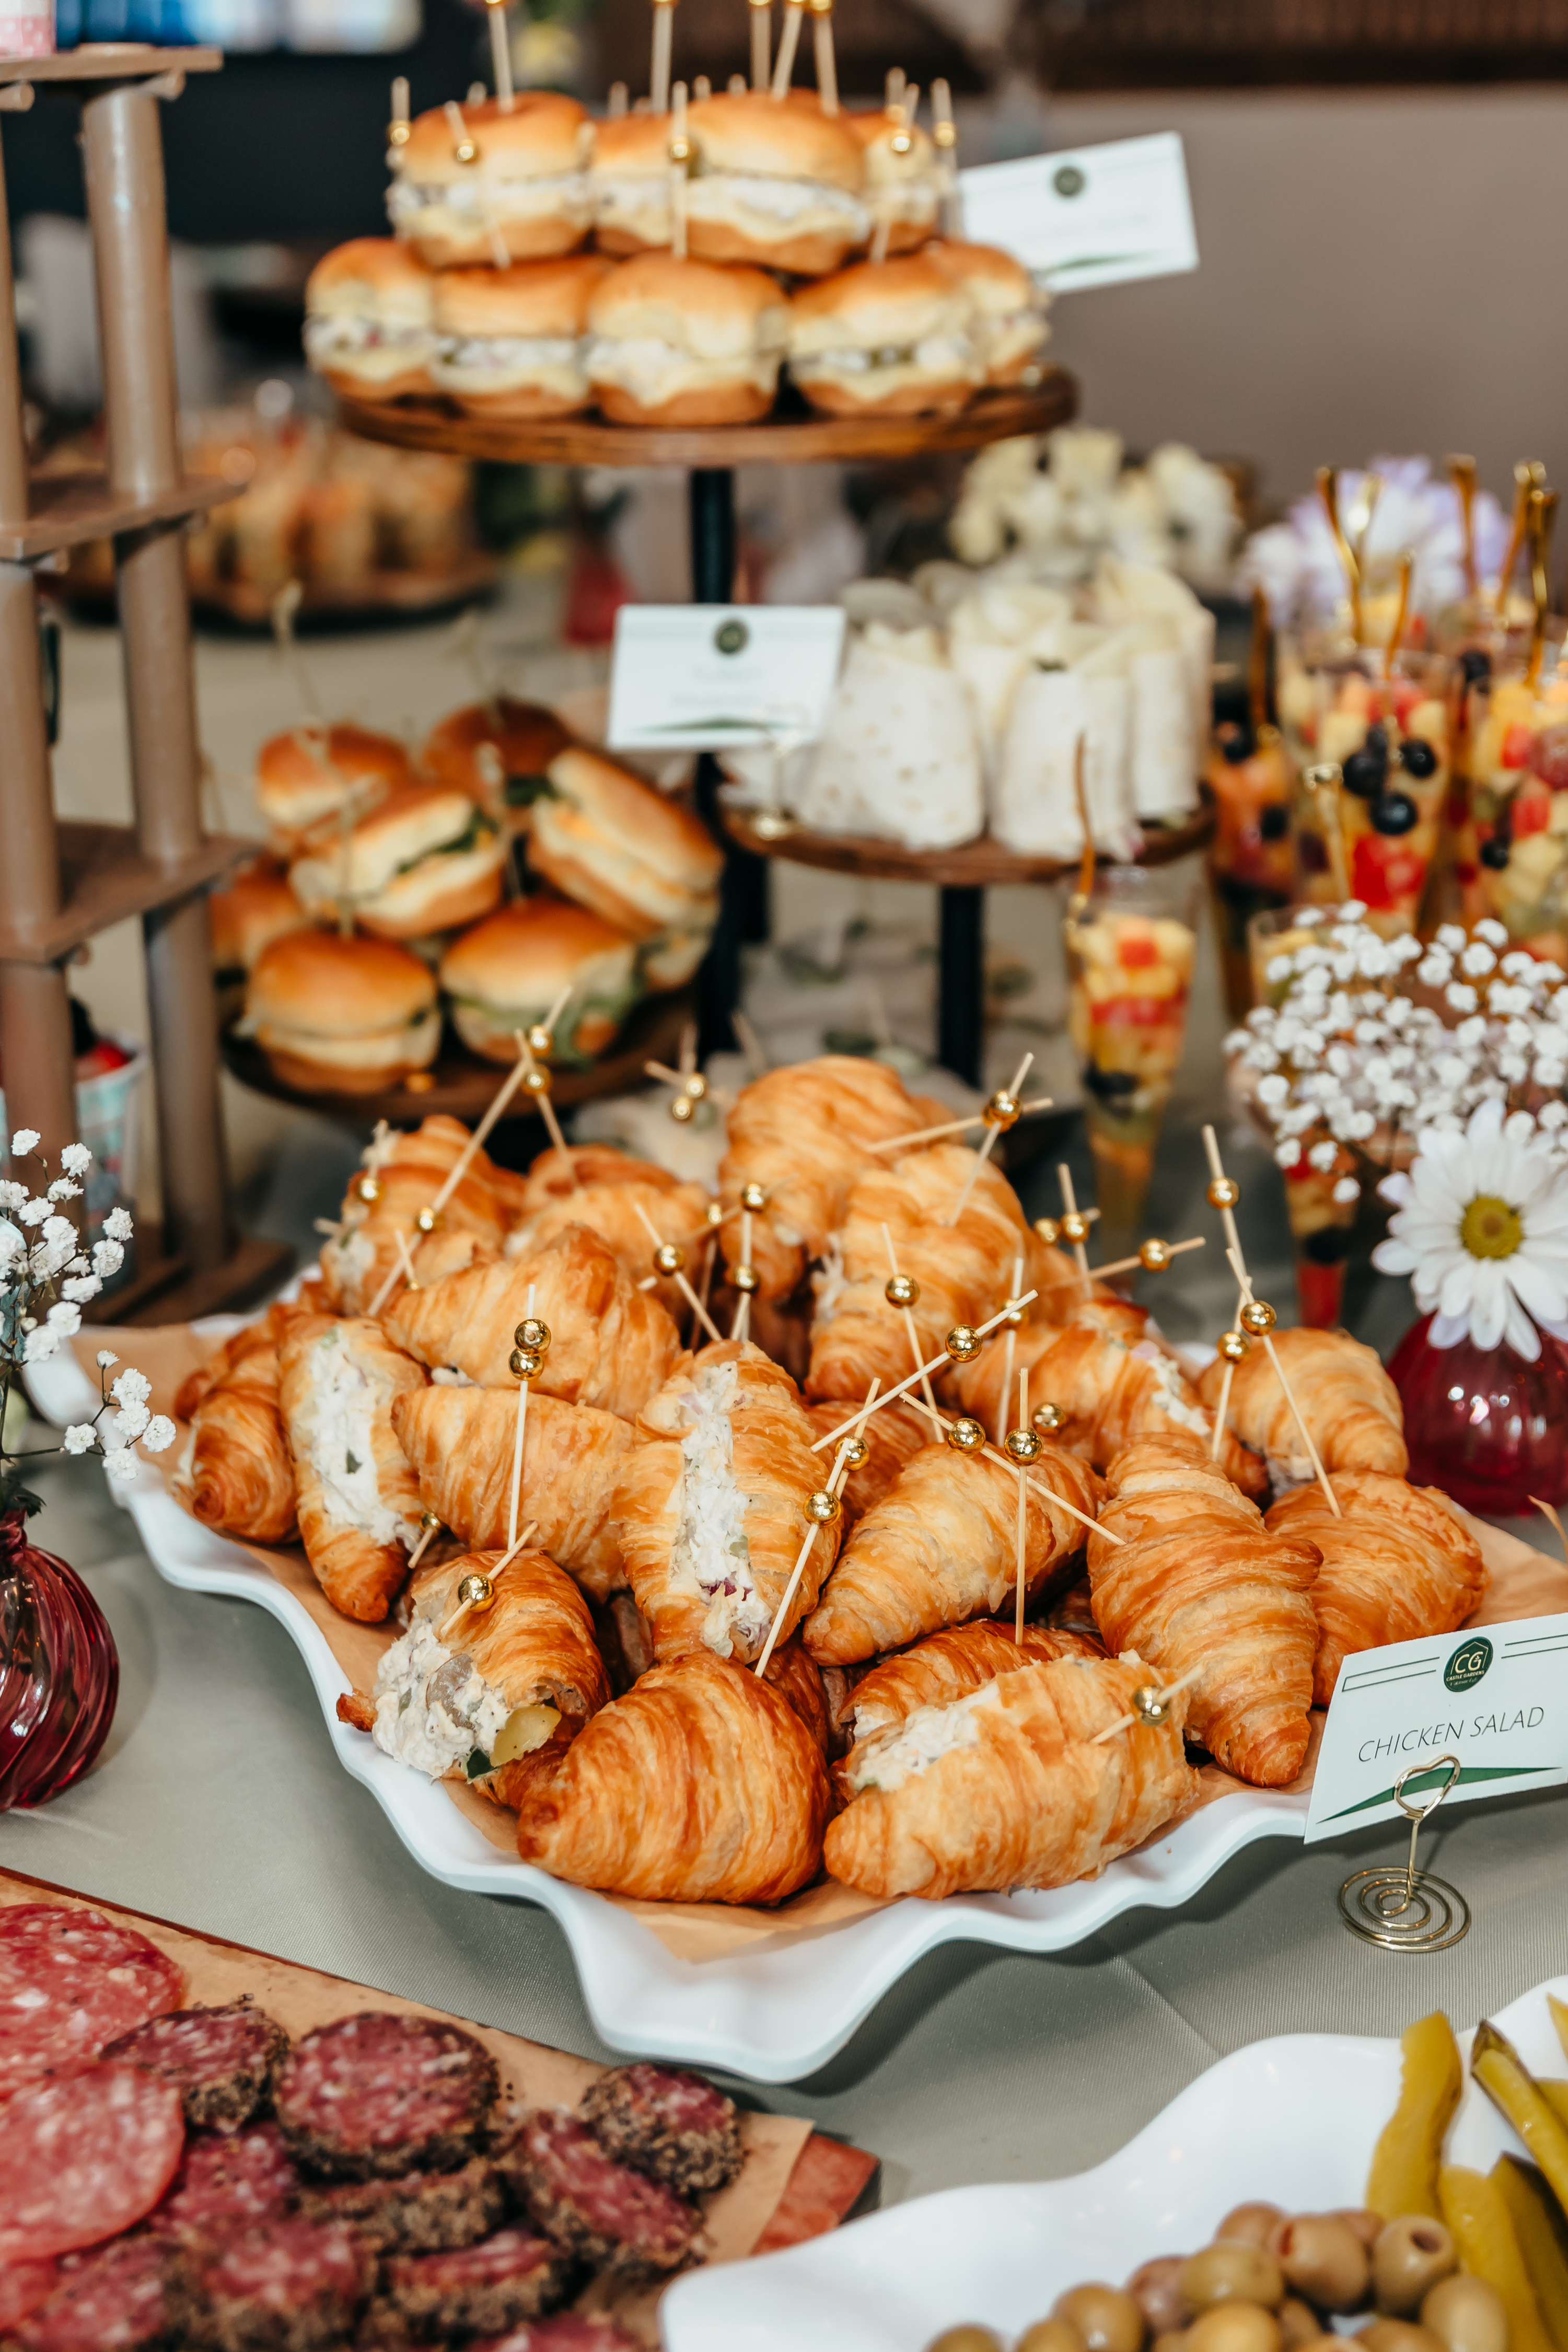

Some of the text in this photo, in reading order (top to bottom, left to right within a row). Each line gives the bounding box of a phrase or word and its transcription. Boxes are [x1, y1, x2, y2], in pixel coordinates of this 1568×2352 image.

[1455, 1651, 1483, 1674] CG
[1358, 1707, 1544, 1762] CHICKEN SALAD
